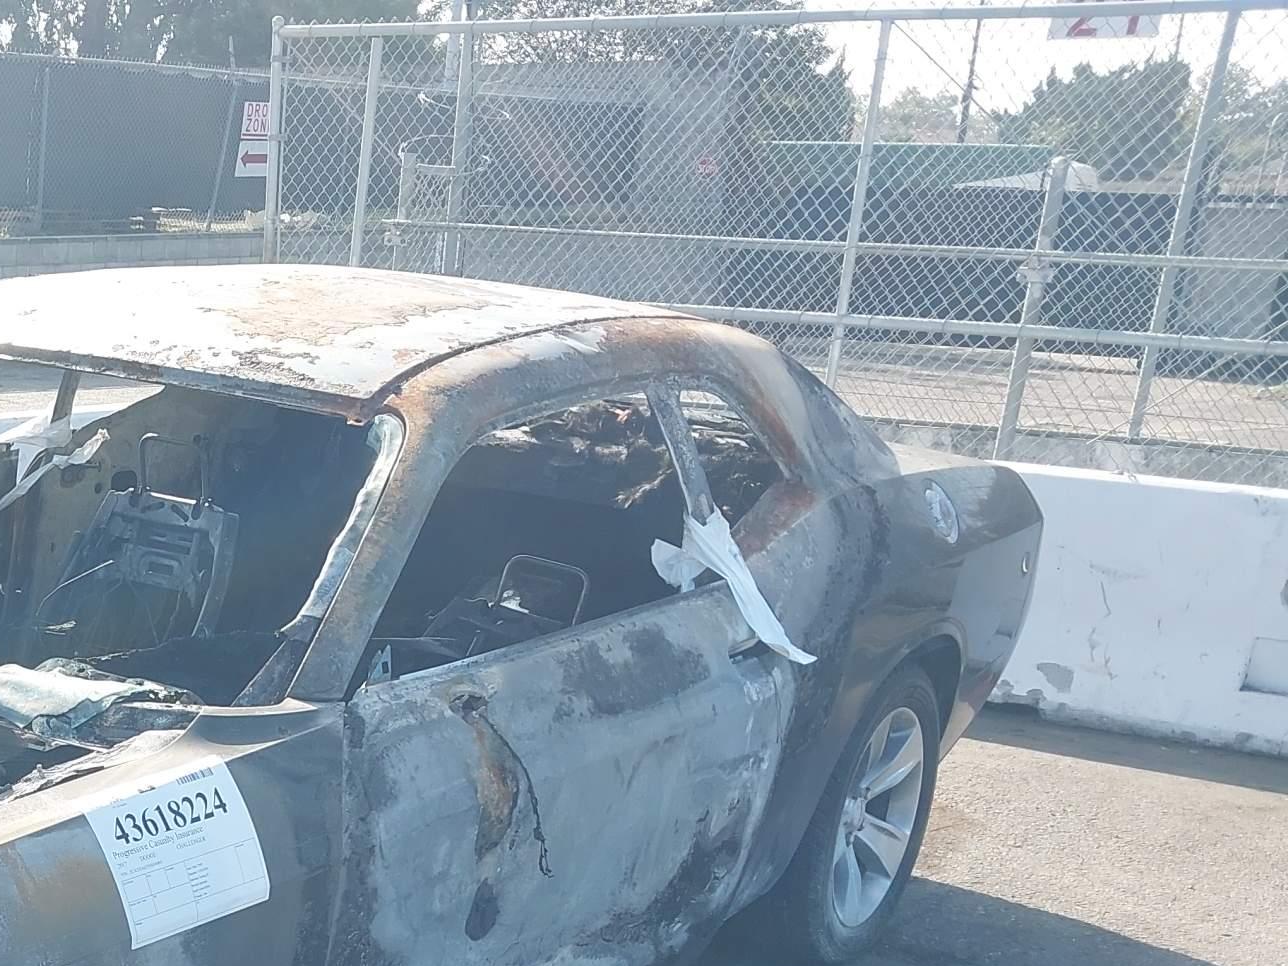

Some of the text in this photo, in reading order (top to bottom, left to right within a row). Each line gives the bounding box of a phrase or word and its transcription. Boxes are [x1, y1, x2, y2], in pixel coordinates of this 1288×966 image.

[247, 103, 269, 118] DRO
[246, 118, 269, 132] ZON
[114, 787, 228, 845] 43618224
[112, 826, 205, 861] Progressive Casualty Insurance
